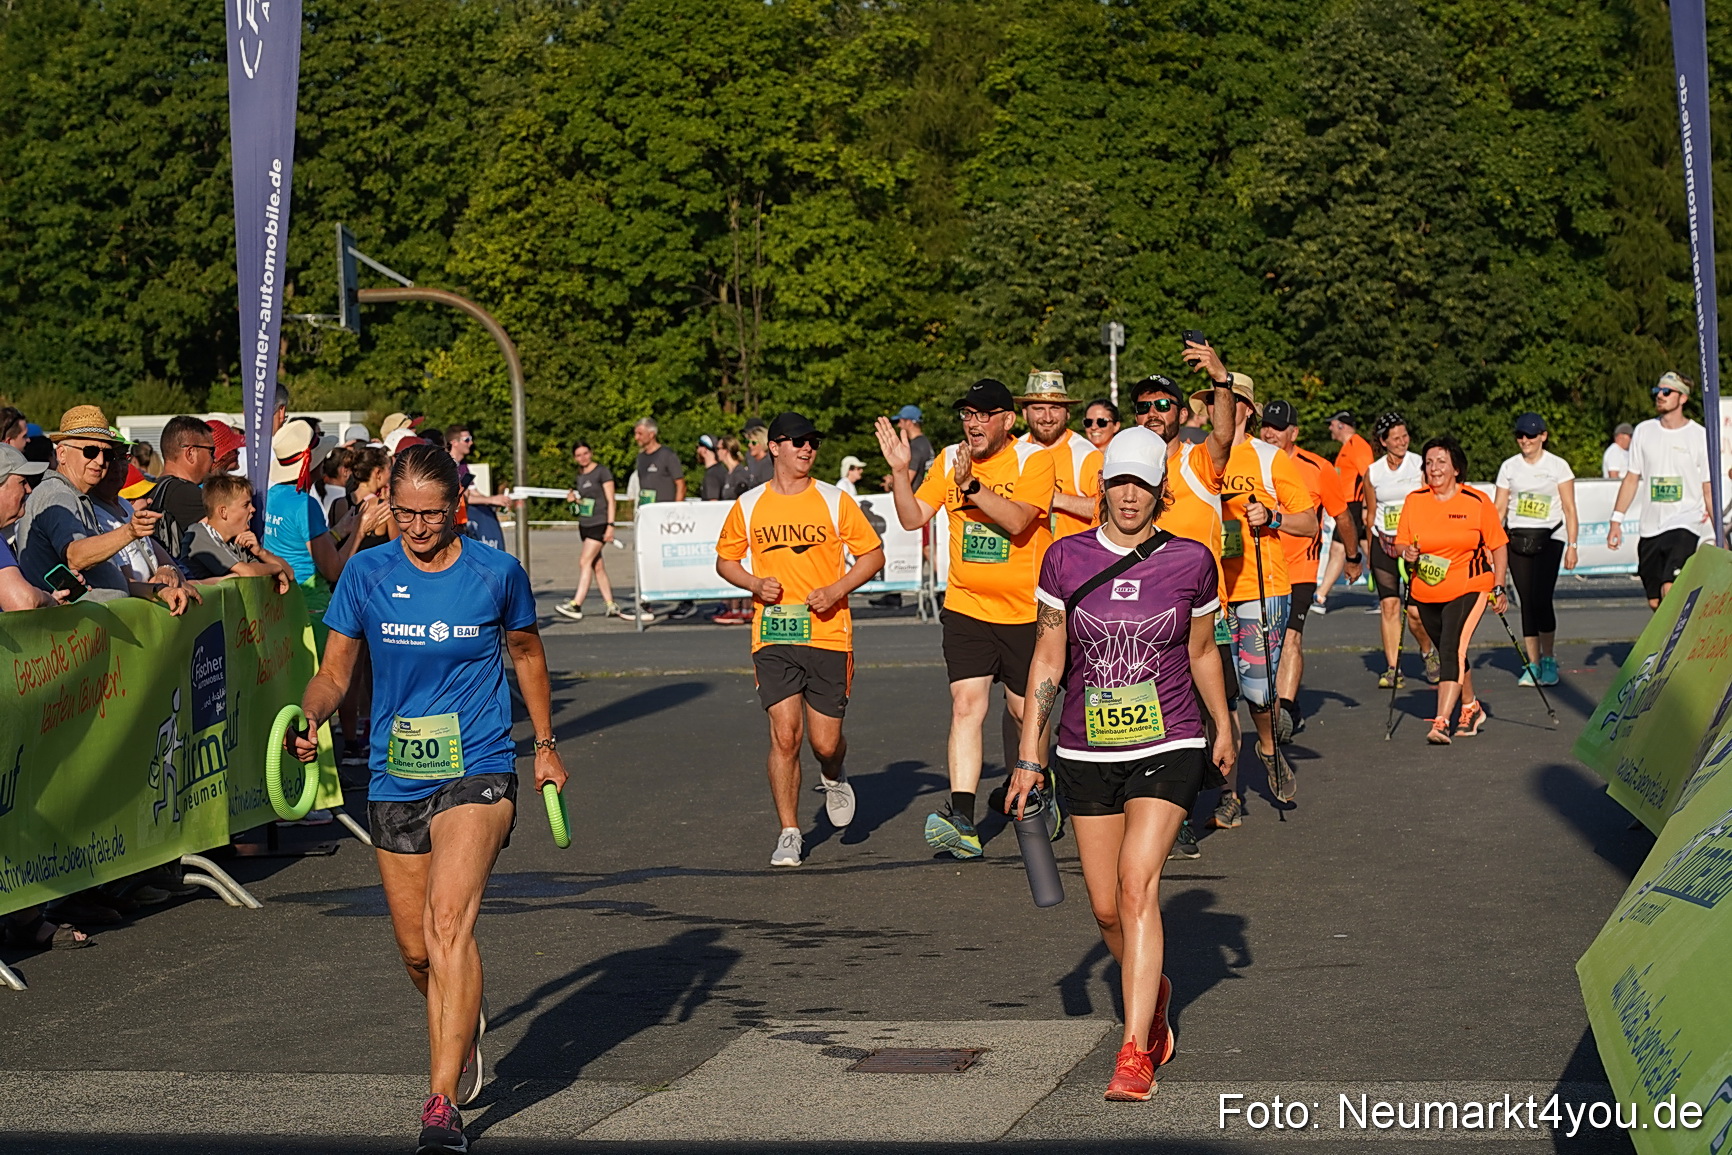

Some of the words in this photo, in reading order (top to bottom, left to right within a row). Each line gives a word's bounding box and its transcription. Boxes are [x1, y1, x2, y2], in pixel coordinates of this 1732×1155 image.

[1522, 500, 1546, 512] 1472
[660, 522, 696, 535] NOW
[762, 524, 826, 543] WINGS
[970, 536, 996, 550] 379
[381, 622, 426, 638] SCHICK
[456, 627, 478, 636] BAU
[771, 618, 798, 631] 513
[14, 634, 70, 696] Gesunde
[195, 655, 223, 682] Fischer
[1088, 710, 1096, 738] WALK
[1096, 704, 1148, 727] 1552
[1149, 704, 1160, 732] 2022
[1129, 724, 1152, 732] Andrea
[398, 738, 440, 760] 730
[448, 738, 459, 768] 2022
[416, 760, 450, 768] Gerlinde
